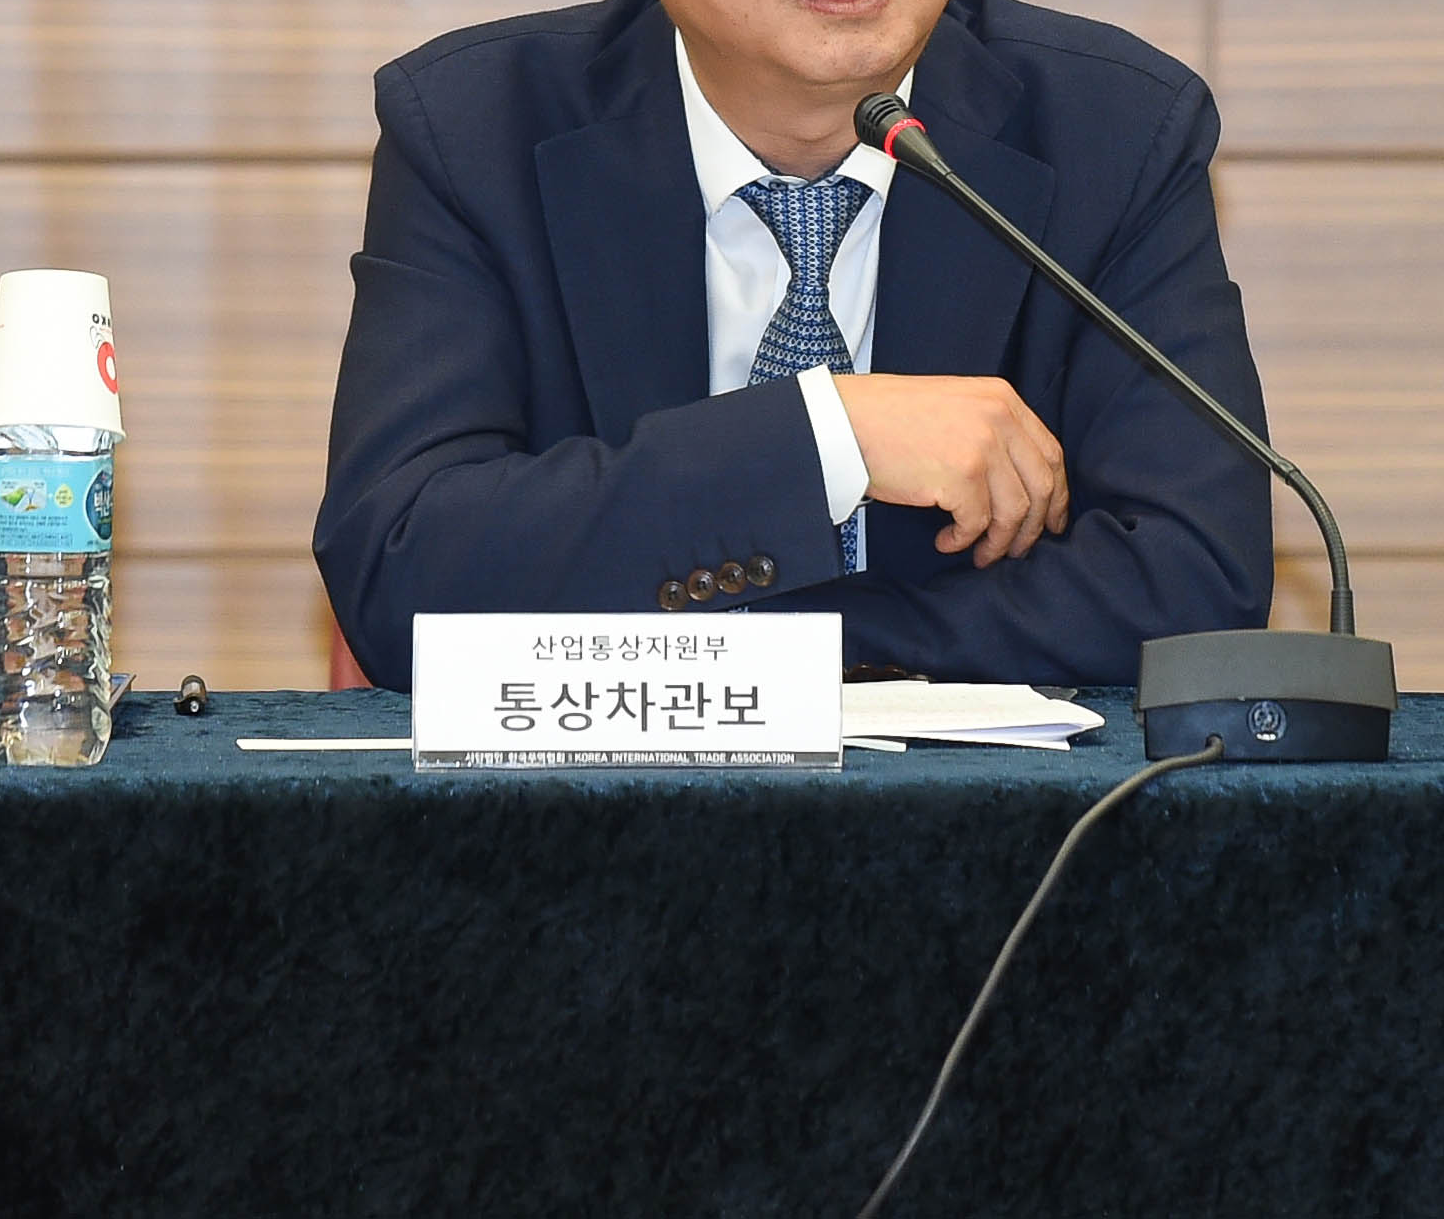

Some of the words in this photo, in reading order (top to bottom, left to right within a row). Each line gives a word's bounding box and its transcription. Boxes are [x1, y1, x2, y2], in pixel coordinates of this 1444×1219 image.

[532, 635, 729, 661] 산업통상자원부
[494, 681, 766, 733] 통상차관보
[574, 751, 607, 764] KOREA
[612, 752, 689, 764] INTERNATIONAL
[694, 752, 726, 764] TRADE
[730, 752, 795, 765] ASSOCIATION
